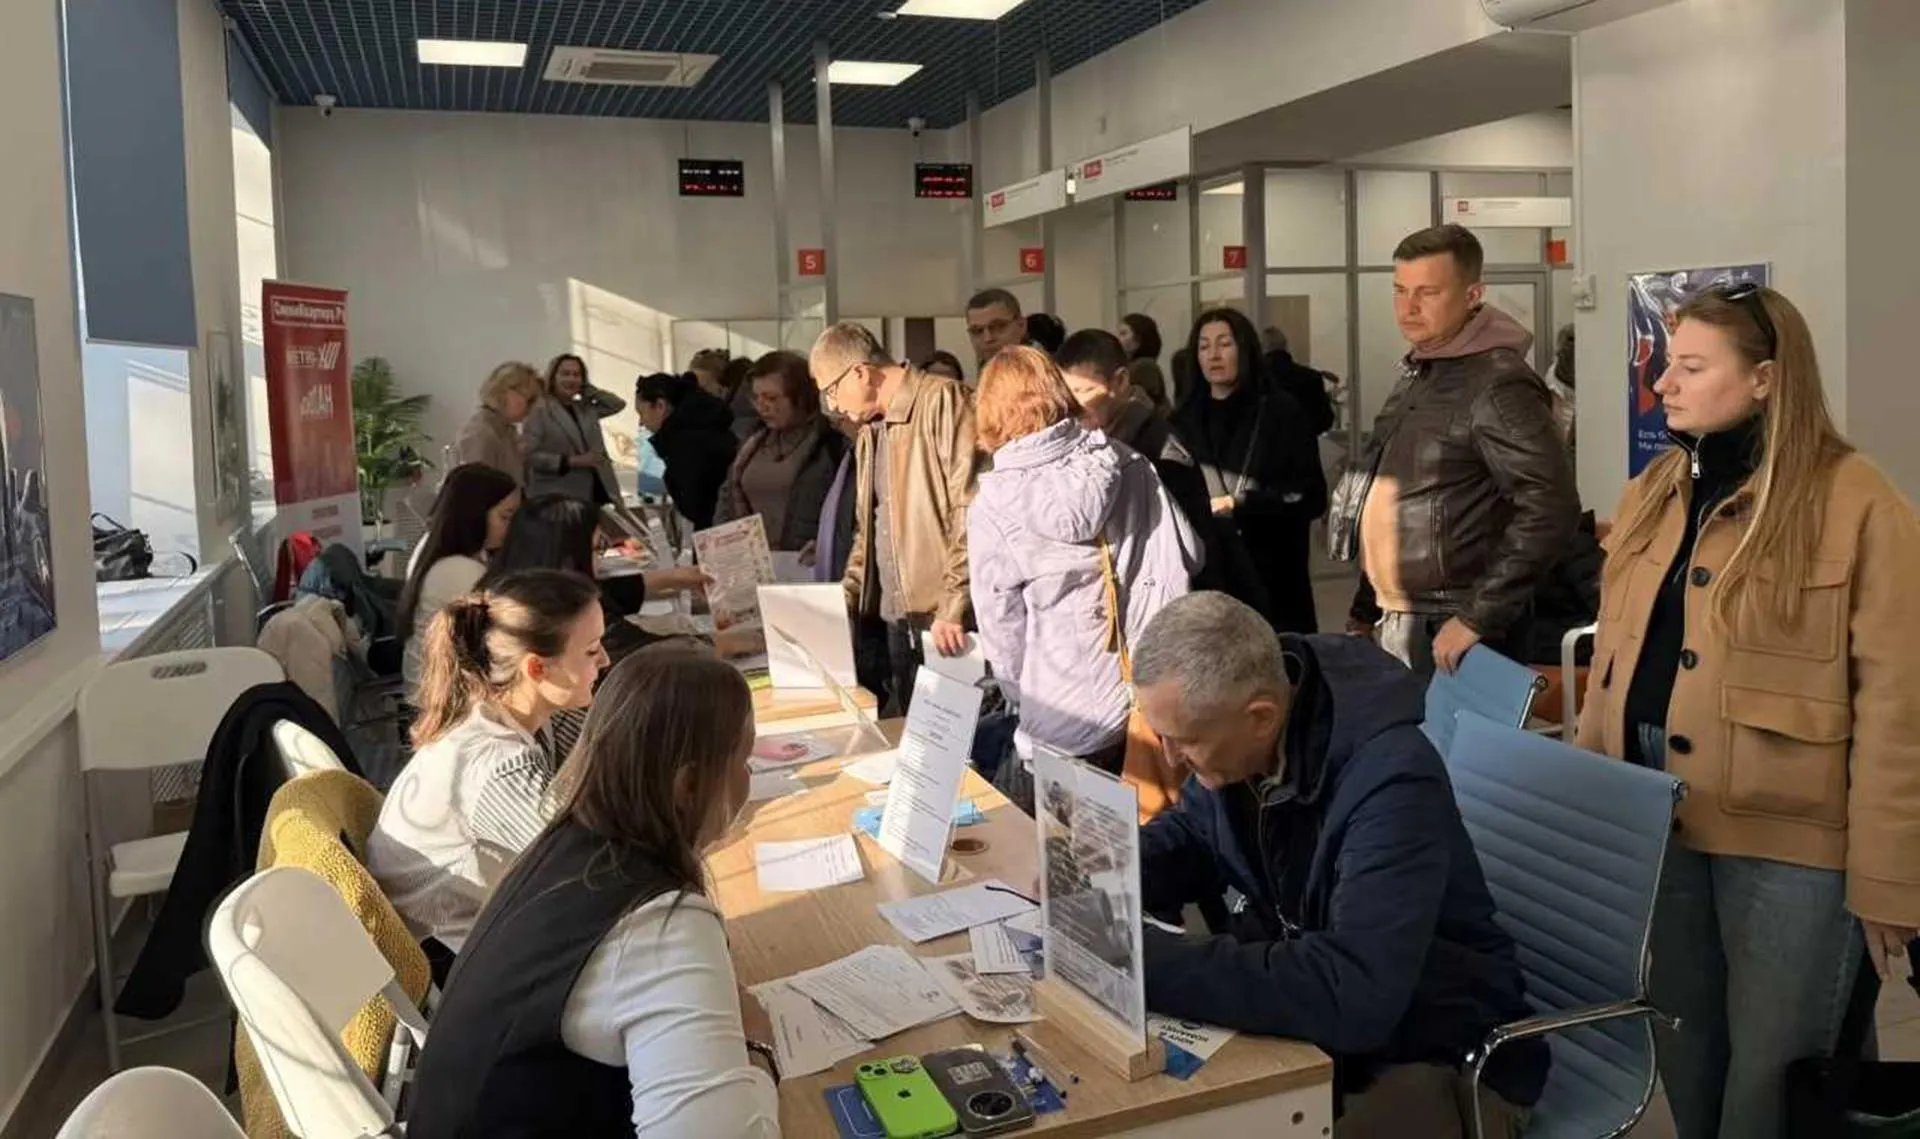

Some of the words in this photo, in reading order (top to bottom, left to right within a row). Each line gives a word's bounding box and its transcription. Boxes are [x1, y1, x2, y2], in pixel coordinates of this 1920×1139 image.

[804, 254, 817, 270] 5
[1025, 253, 1037, 268] 6
[1228, 251, 1240, 264] 7
